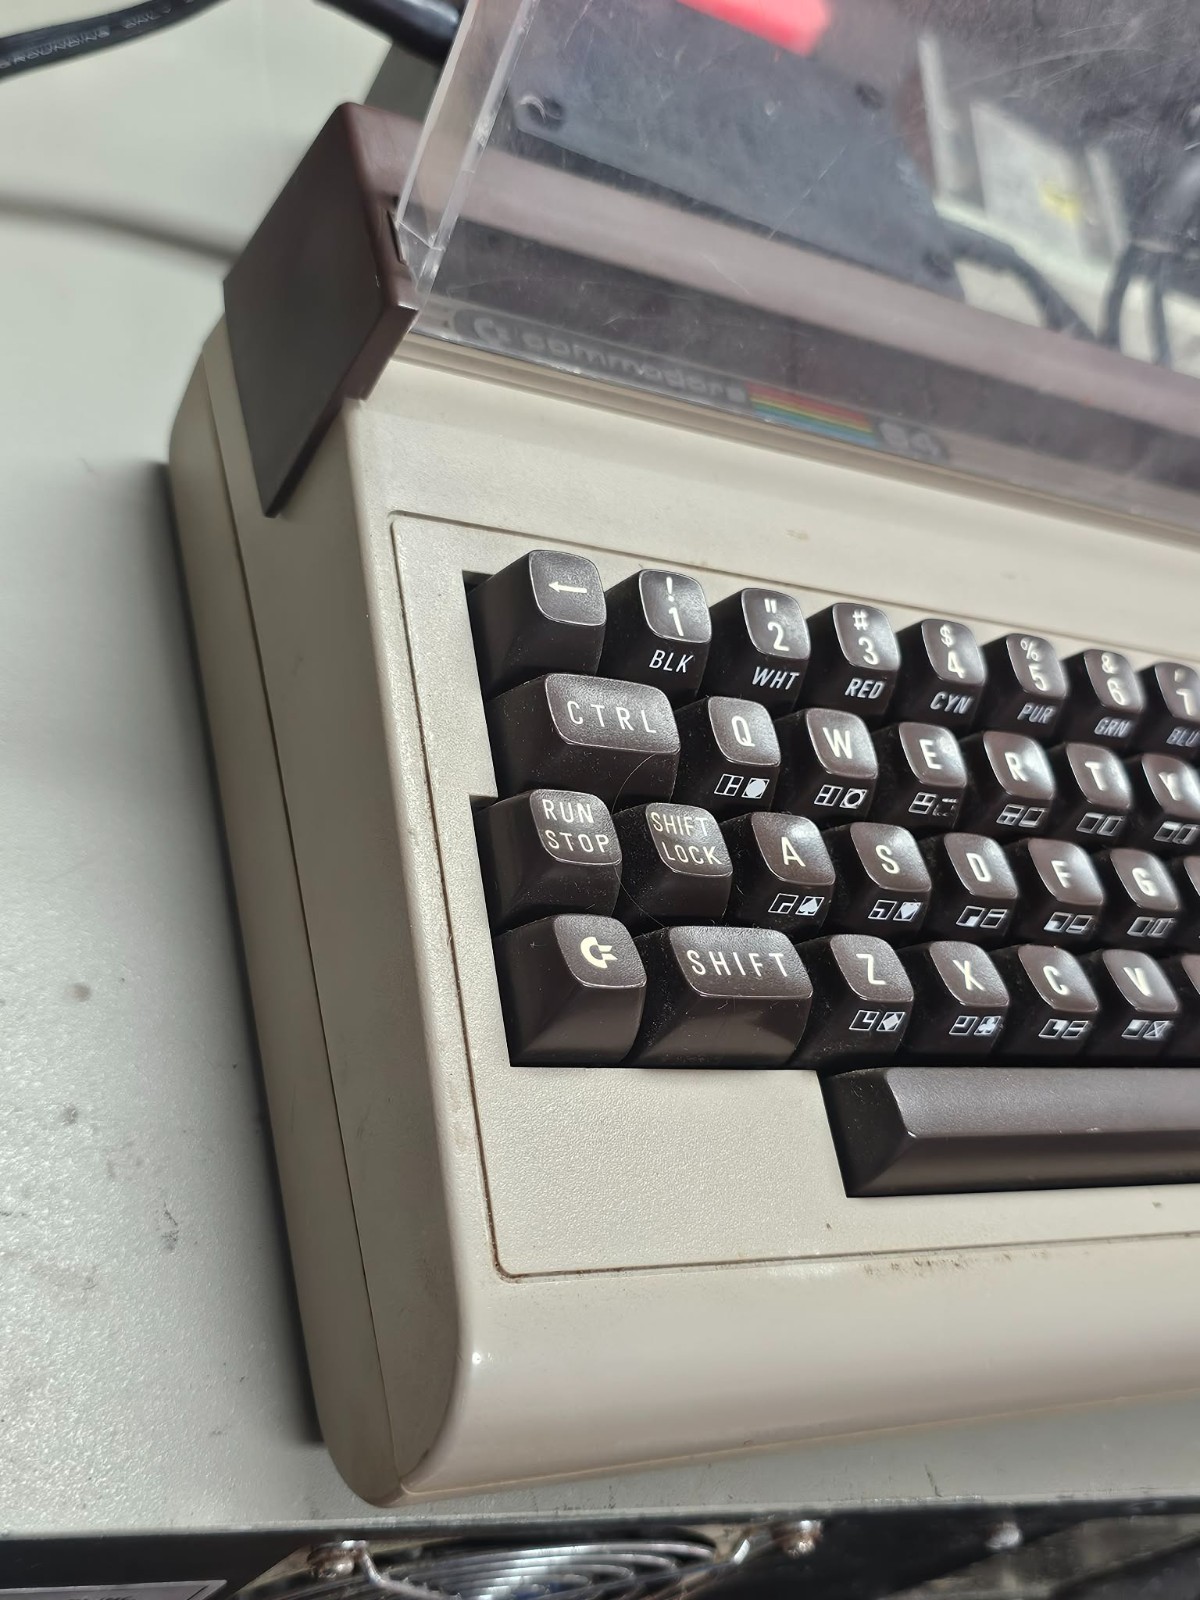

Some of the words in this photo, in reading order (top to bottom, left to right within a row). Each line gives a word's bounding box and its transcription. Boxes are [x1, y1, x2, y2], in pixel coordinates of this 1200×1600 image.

[666, 577, 675, 602] !
[668, 607, 684, 637] 1
[852, 609, 868, 631] #
[767, 622, 789, 652] 2
[939, 624, 954, 648] $
[649, 650, 694, 673] BLK
[858, 637, 879, 665] 3
[1020, 639, 1039, 661] %
[752, 666, 801, 690] WHT
[947, 651, 964, 678] 4
[1101, 655, 1118, 674] &
[845, 678, 884, 699] RED
[1029, 666, 1047, 691] 5
[930, 692, 972, 715] CYN
[1107, 679, 1126, 706] 6
[566, 700, 657, 734] CTRL
[1017, 703, 1052, 724] PUR
[731, 716, 756, 747] Q
[1094, 718, 1133, 738] GRN
[823, 727, 852, 759] W
[919, 738, 942, 770] E
[1005, 752, 1029, 782] R
[1085, 761, 1105, 791] T
[542, 799, 595, 824] RUN
[650, 811, 709, 837] SHIFT
[545, 830, 610, 854] STOP
[662, 841, 723, 866] LOCK
[780, 836, 806, 867] A
[875, 844, 900, 875] S
[966, 852, 991, 882] D
[1051, 860, 1073, 889] F
[1132, 867, 1157, 897] G
[686, 950, 789, 977] SHIFT
[856, 953, 887, 985] Z
[953, 959, 986, 992] X
[1043, 965, 1069, 996] C
[1122, 966, 1153, 997] V
